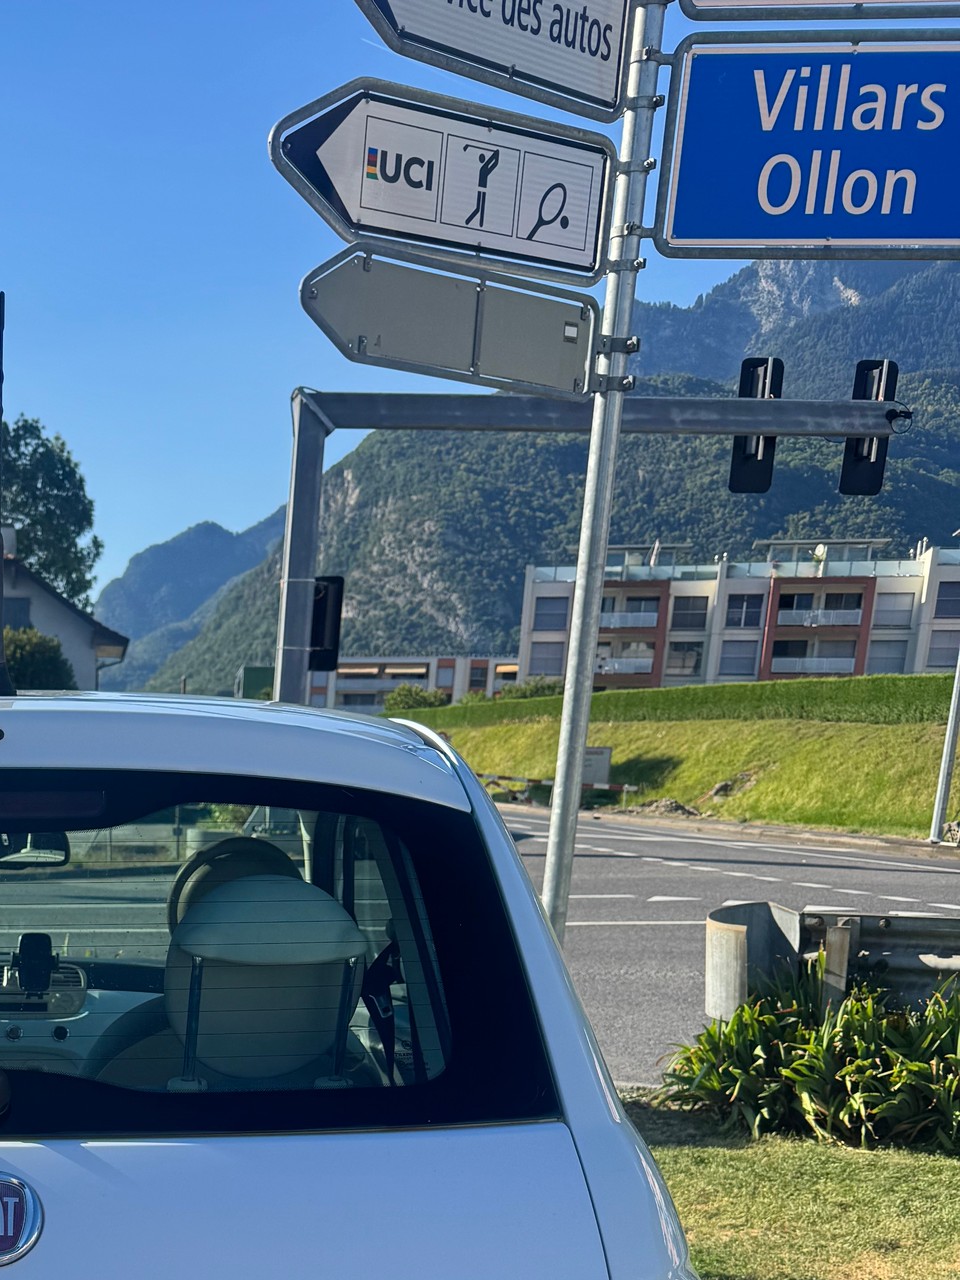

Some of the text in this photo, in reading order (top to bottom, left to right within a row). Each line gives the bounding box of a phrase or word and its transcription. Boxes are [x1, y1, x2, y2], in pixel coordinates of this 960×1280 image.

[549, 3, 613, 62] autos
[753, 63, 948, 132] Villars
[379, 149, 435, 192] UCI
[757, 149, 918, 216] Ollon
